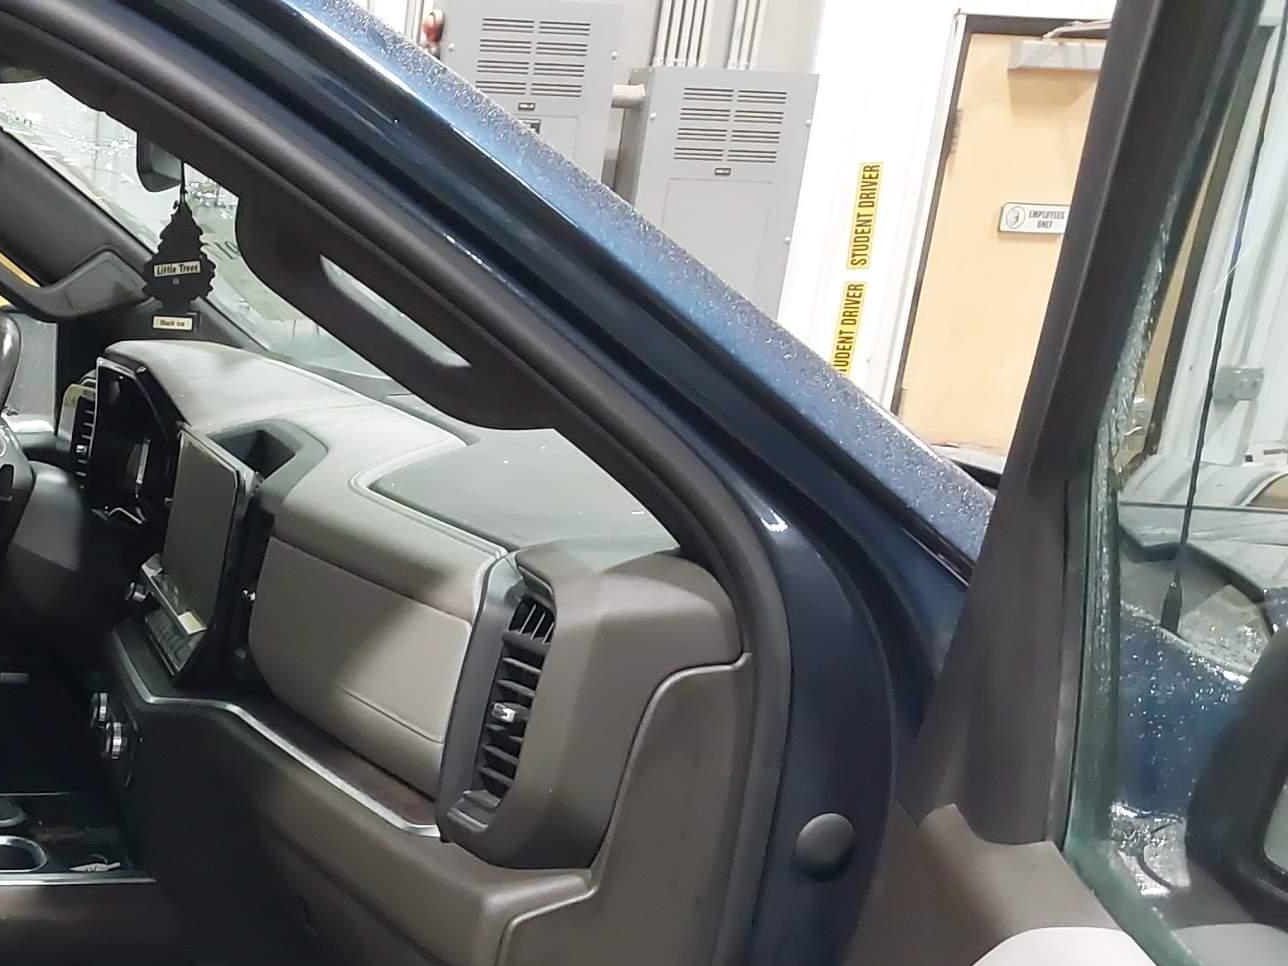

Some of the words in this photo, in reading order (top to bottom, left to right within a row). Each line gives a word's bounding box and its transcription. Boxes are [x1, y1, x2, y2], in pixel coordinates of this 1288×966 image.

[858, 164, 881, 208] DRIVER
[1029, 210, 1065, 219] EMPLOYEES
[1037, 221, 1053, 229] ONLY
[850, 211, 875, 266] STUDENT
[157, 265, 177, 275] Little
[178, 264, 198, 274] Trees
[841, 283, 864, 325] DRIVER
